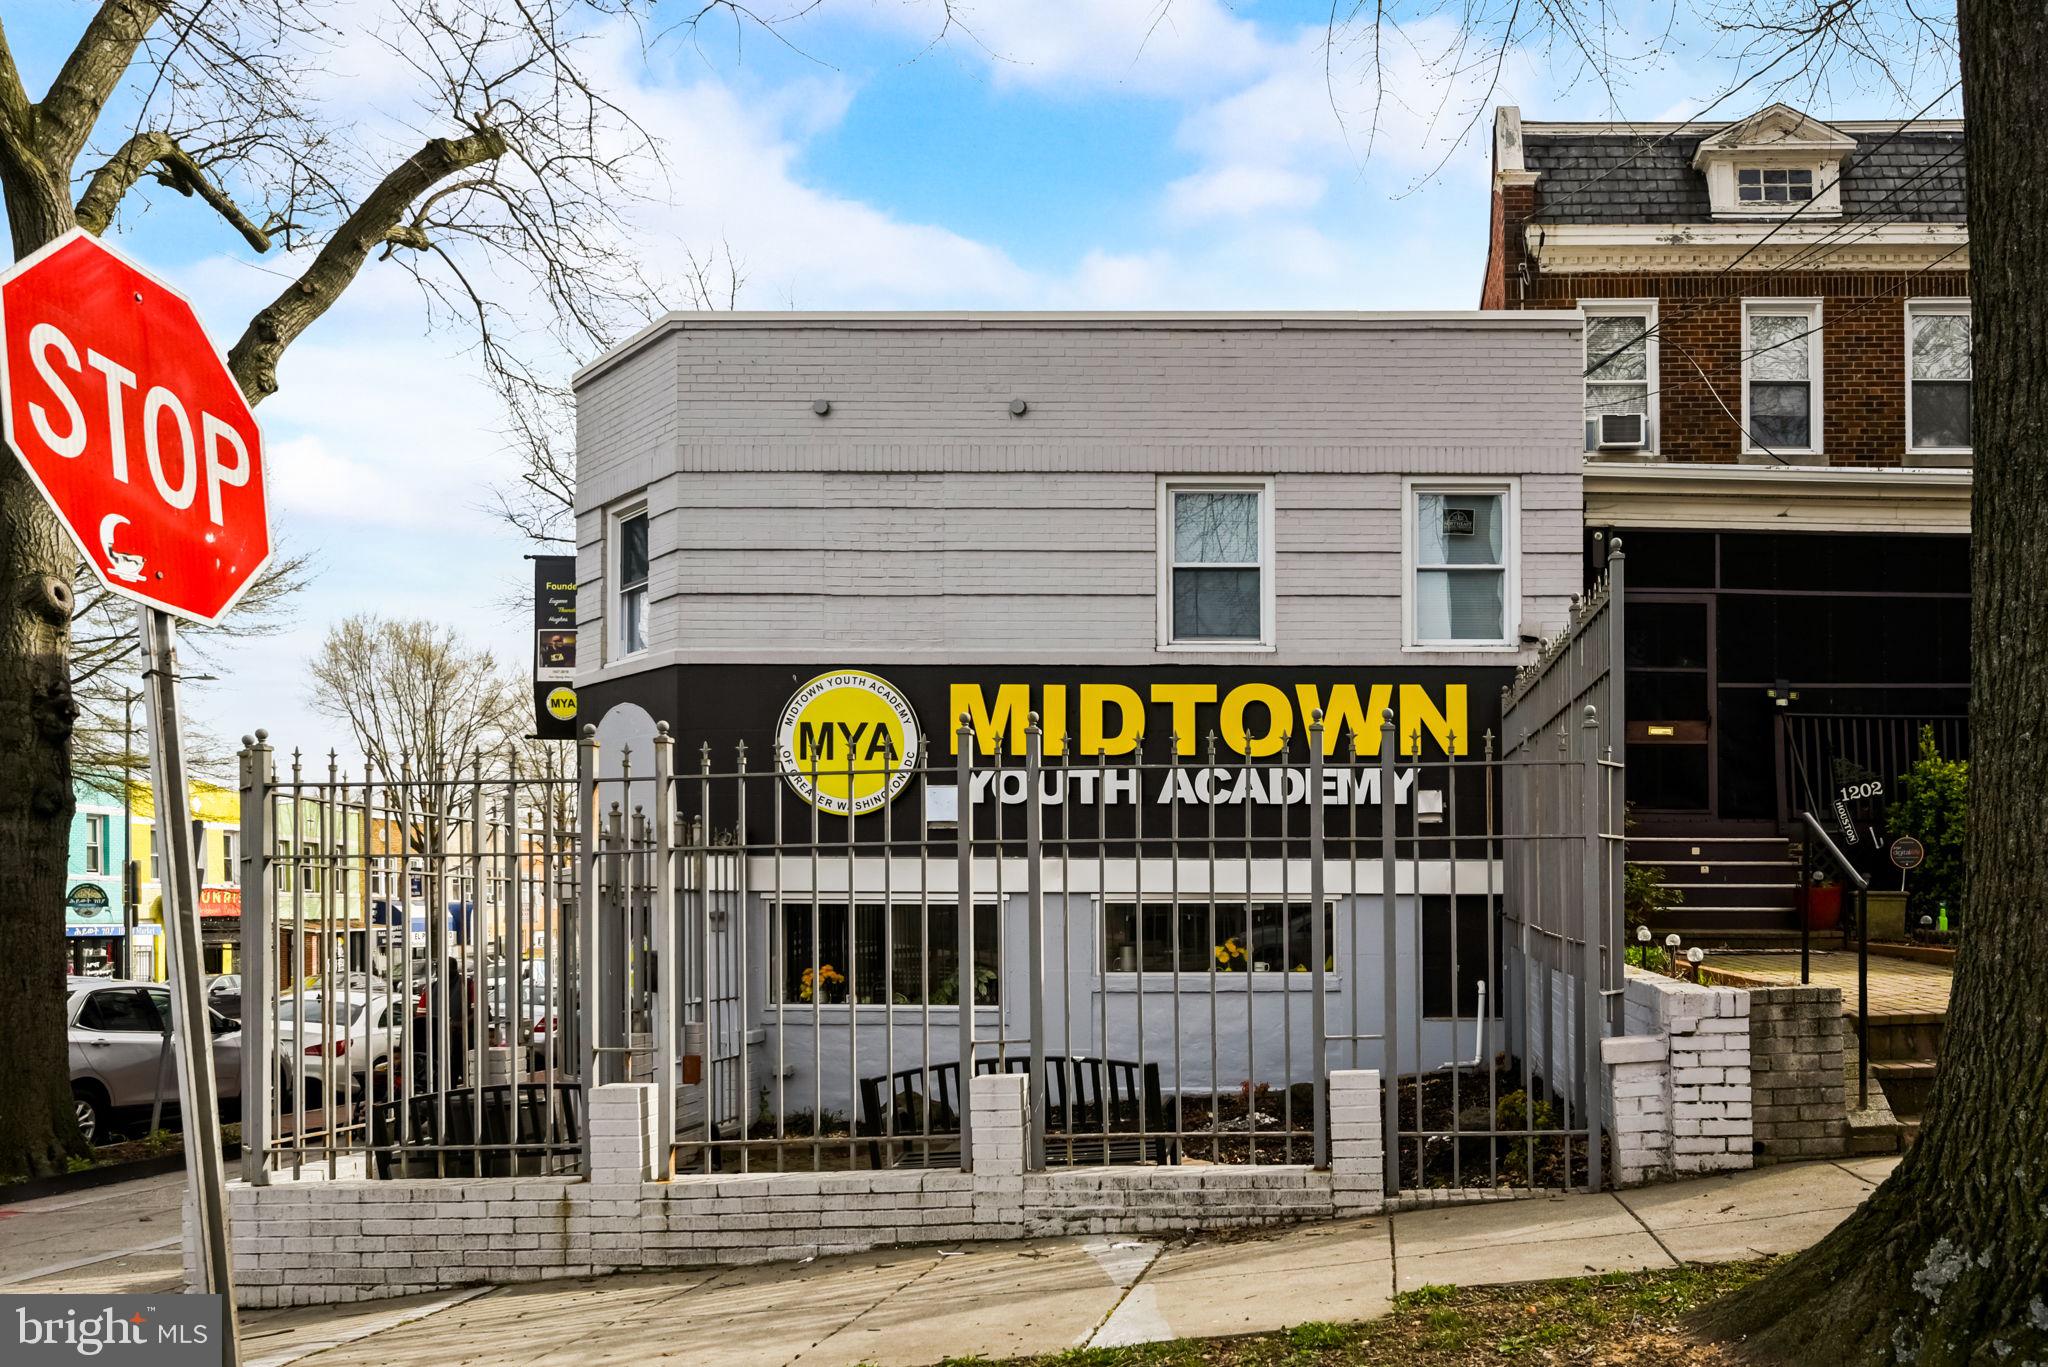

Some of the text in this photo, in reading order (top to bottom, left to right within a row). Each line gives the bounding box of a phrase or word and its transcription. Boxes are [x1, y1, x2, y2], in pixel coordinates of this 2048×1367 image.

[29, 322, 251, 527] STOP
[549, 616, 568, 624] Hughes
[551, 698, 576, 708] MYA
[785, 676, 912, 727] MIDTOWN YOUTH ACADEMY
[949, 683, 1468, 757] MIDTOWN
[800, 721, 899, 761] MYA
[782, 750, 794, 766] OF
[790, 768, 833, 807] GREAER
[904, 751, 915, 768] DC
[968, 766, 1421, 805] YOUTH ACADEMY
[1840, 781, 1884, 802] 1202
[1835, 802, 1857, 842] HOUSTON
